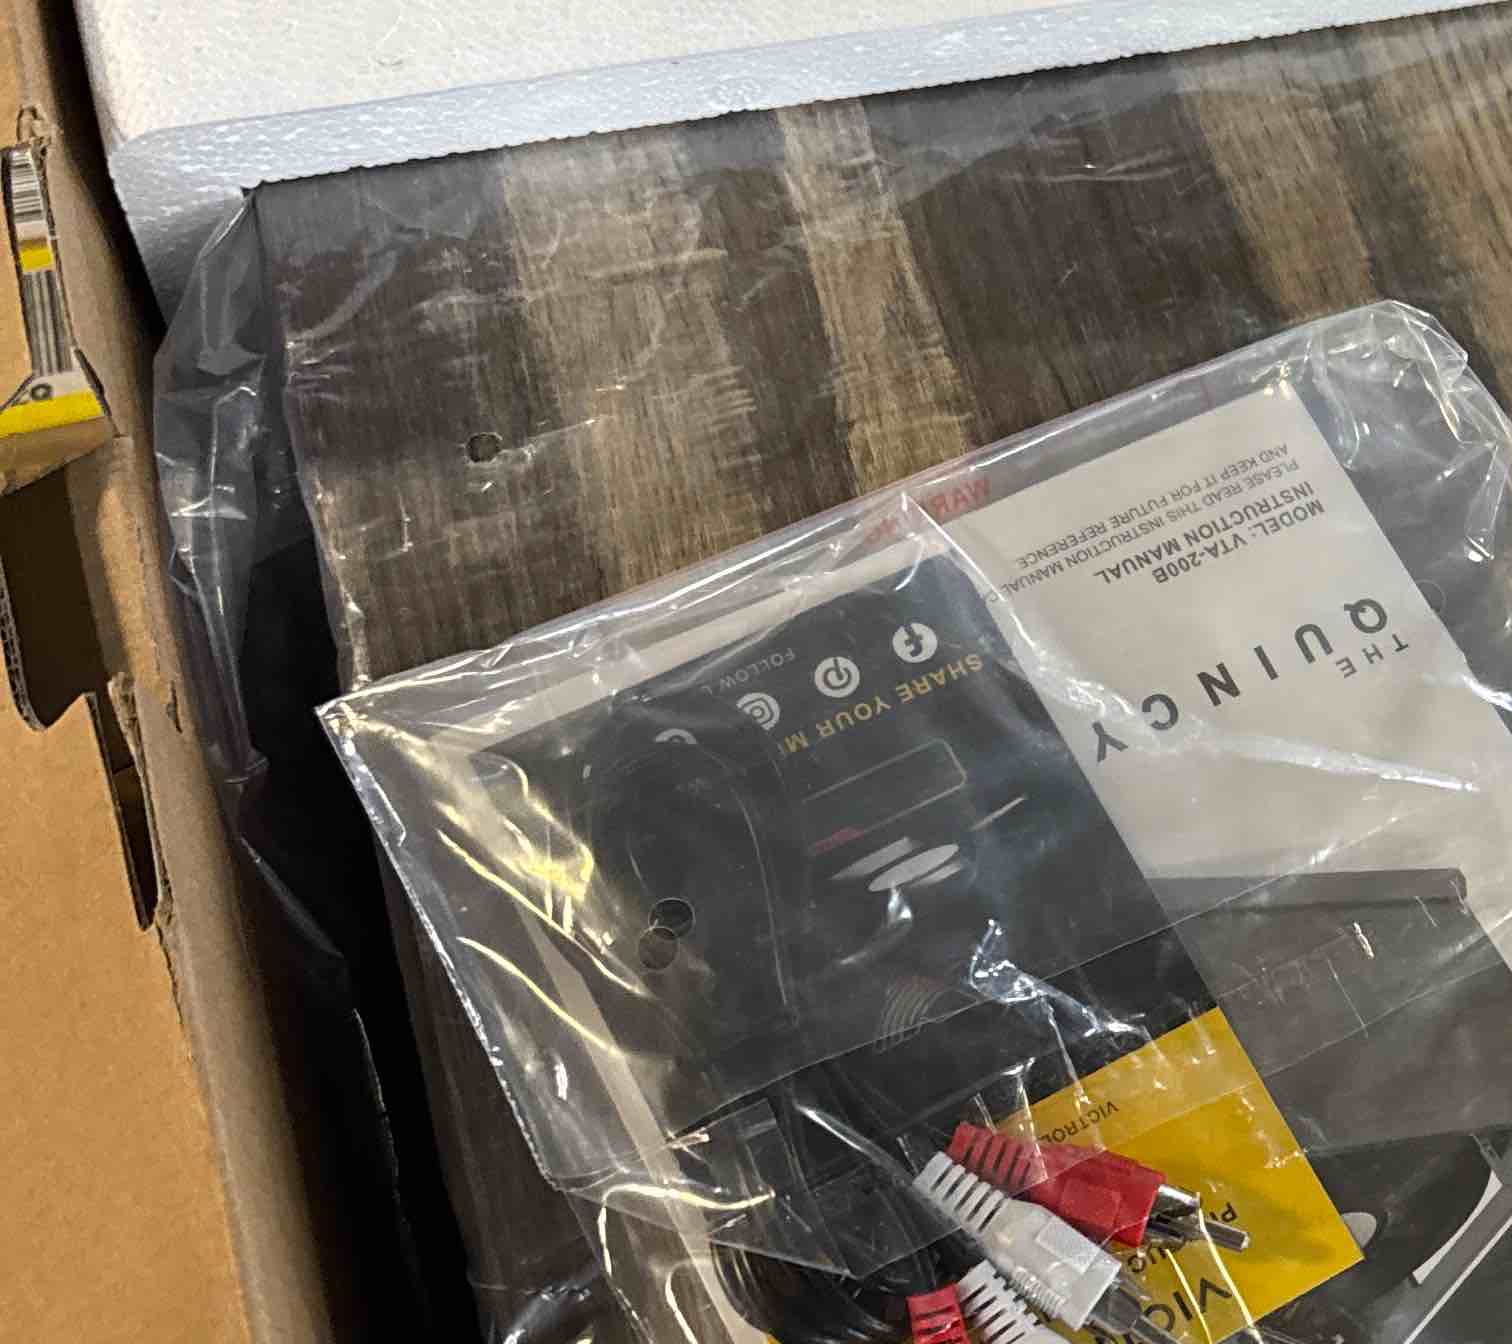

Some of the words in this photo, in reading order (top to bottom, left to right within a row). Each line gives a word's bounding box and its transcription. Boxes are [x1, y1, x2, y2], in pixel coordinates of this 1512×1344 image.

[1221, 456, 1258, 480] KEEP
[1259, 444, 1288, 463] AND
[1169, 480, 1200, 501] FOR
[1202, 483, 1241, 507] READ
[1203, 471, 1218, 485] IT
[1244, 459, 1299, 490] PLEASE
[1109, 495, 1168, 527] FUTURE
[1166, 499, 1200, 522] THIS
[1183, 481, 1313, 546] INSTRUCTION
[1248, 499, 1324, 540] MODEL:
[1016, 521, 1107, 568] REFERENCE
[1064, 517, 1164, 567] INSTRUCTION
[1093, 537, 1181, 585] MANUAL
[1152, 534, 1245, 584] VTA-200B
[1000, 561, 1062, 594] MANUAL
[719, 647, 794, 687] FOLLOW
[1336, 634, 1409, 678] THE
[895, 654, 982, 704] SHARE
[1092, 598, 1388, 764] QUINCY
[816, 694, 891, 737] YOUR
[1038, 1100, 1119, 1145] VICTROL
